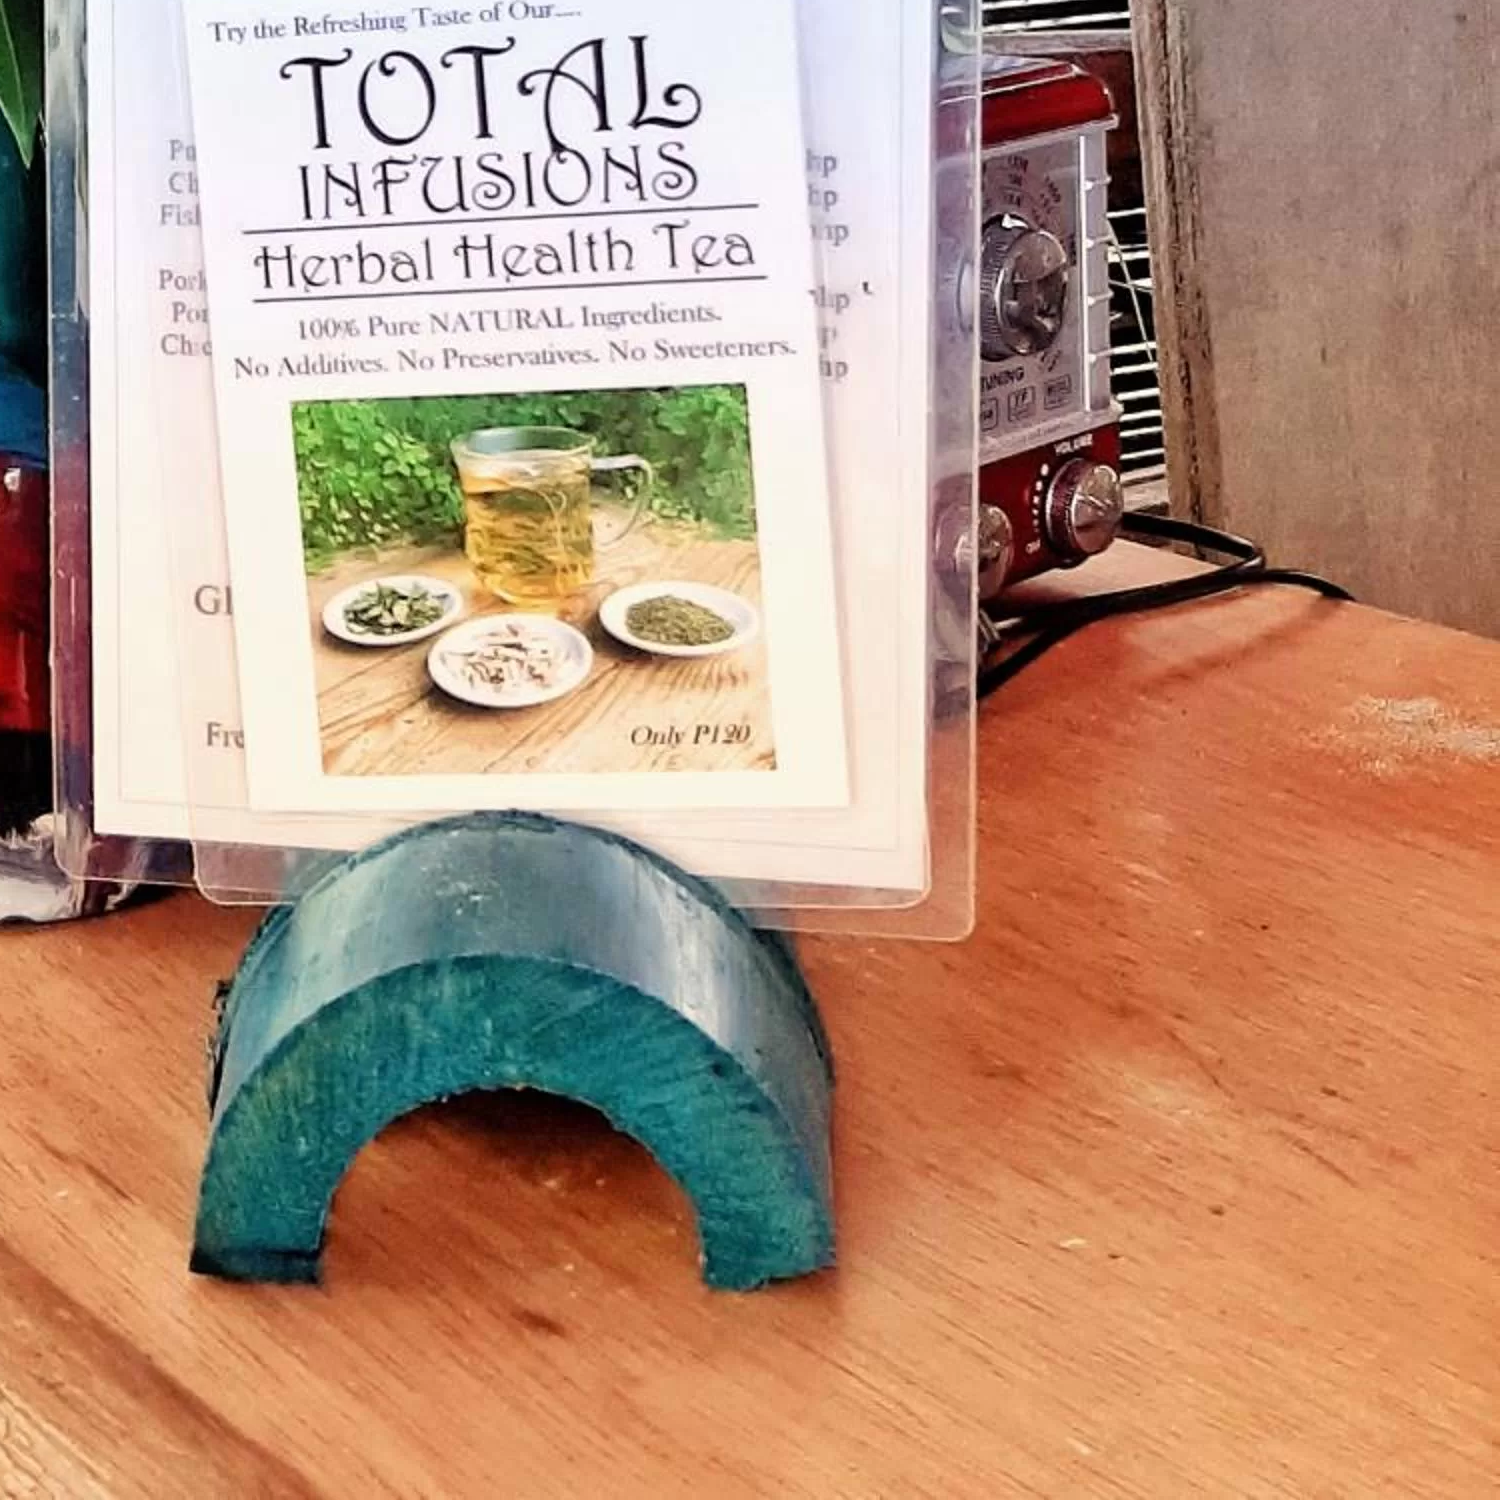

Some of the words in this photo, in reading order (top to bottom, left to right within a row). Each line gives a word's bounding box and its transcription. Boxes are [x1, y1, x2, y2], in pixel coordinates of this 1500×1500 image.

[207, 21, 247, 45] Try
[253, 19, 286, 40] the
[293, 11, 408, 37] Refreshing
[412, 6, 473, 28] Taste
[479, 1, 504, 23] of
[279, 35, 703, 152] TOTAL
[298, 140, 699, 221] INFUSIONS
[253, 237, 435, 293] Herbal
[453, 226, 634, 283] Health
[651, 218, 756, 275] Tea
[298, 316, 361, 341] 100%
[368, 314, 421, 338] Pure
[429, 305, 575, 334] NATURAL
[581, 301, 723, 331] Ingredients.
[234, 356, 270, 380] No
[277, 352, 389, 378] Additives.
[397, 349, 435, 373] No
[442, 342, 600, 370] Preservatives.
[608, 339, 647, 363] No
[653, 338, 797, 363] Sweeteners.
[630, 724, 686, 749] Only
[693, 723, 751, 745] P120
